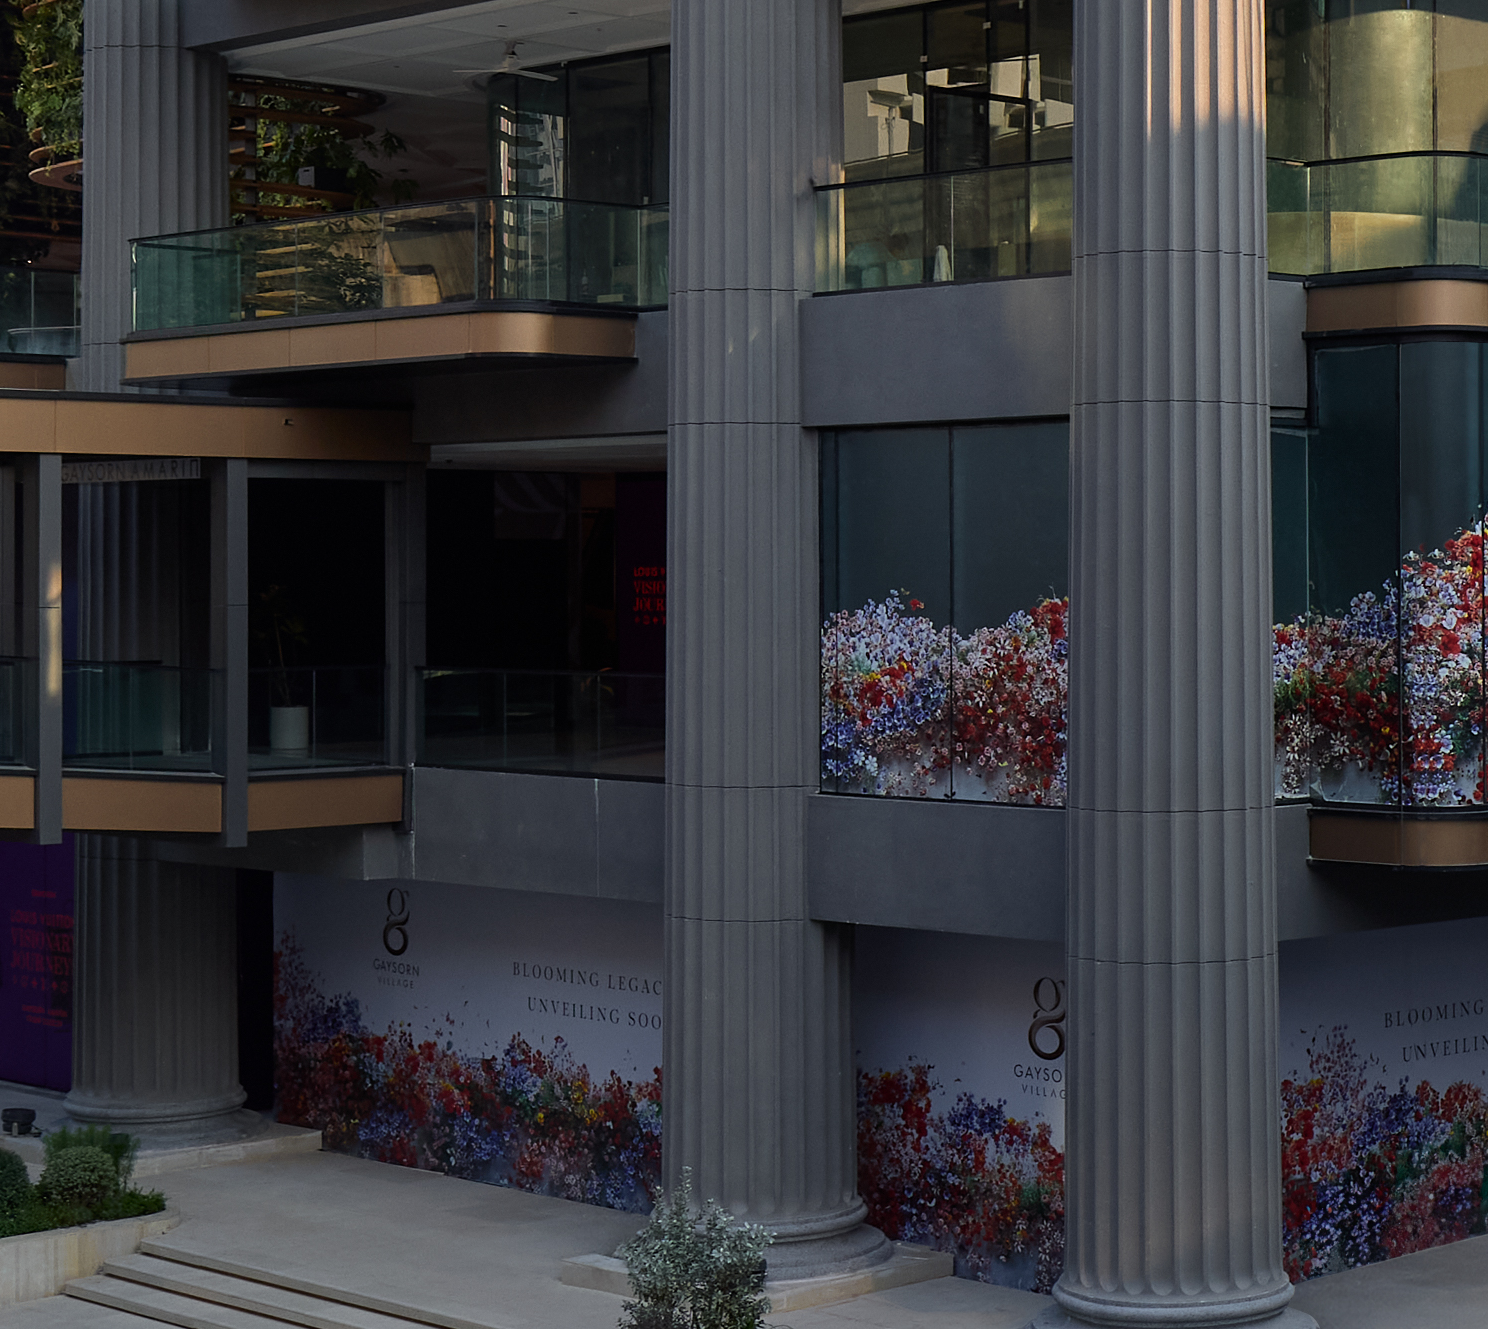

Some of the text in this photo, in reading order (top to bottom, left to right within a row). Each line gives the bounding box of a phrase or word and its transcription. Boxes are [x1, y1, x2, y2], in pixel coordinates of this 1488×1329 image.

[633, 581, 666, 594] VISIO
[633, 597, 665, 612] JOUR
[373, 958, 420, 976] GAYSORN
[377, 976, 414, 989] VILLAGE
[513, 961, 662, 995] BLOOMING LEGAC
[528, 996, 662, 1030] UNVEILING SOO
[1384, 999, 1484, 1028] BLOOMING
[1013, 1064, 1062, 1083] GAYSO
[1022, 1083, 1066, 1100] VILLAG
